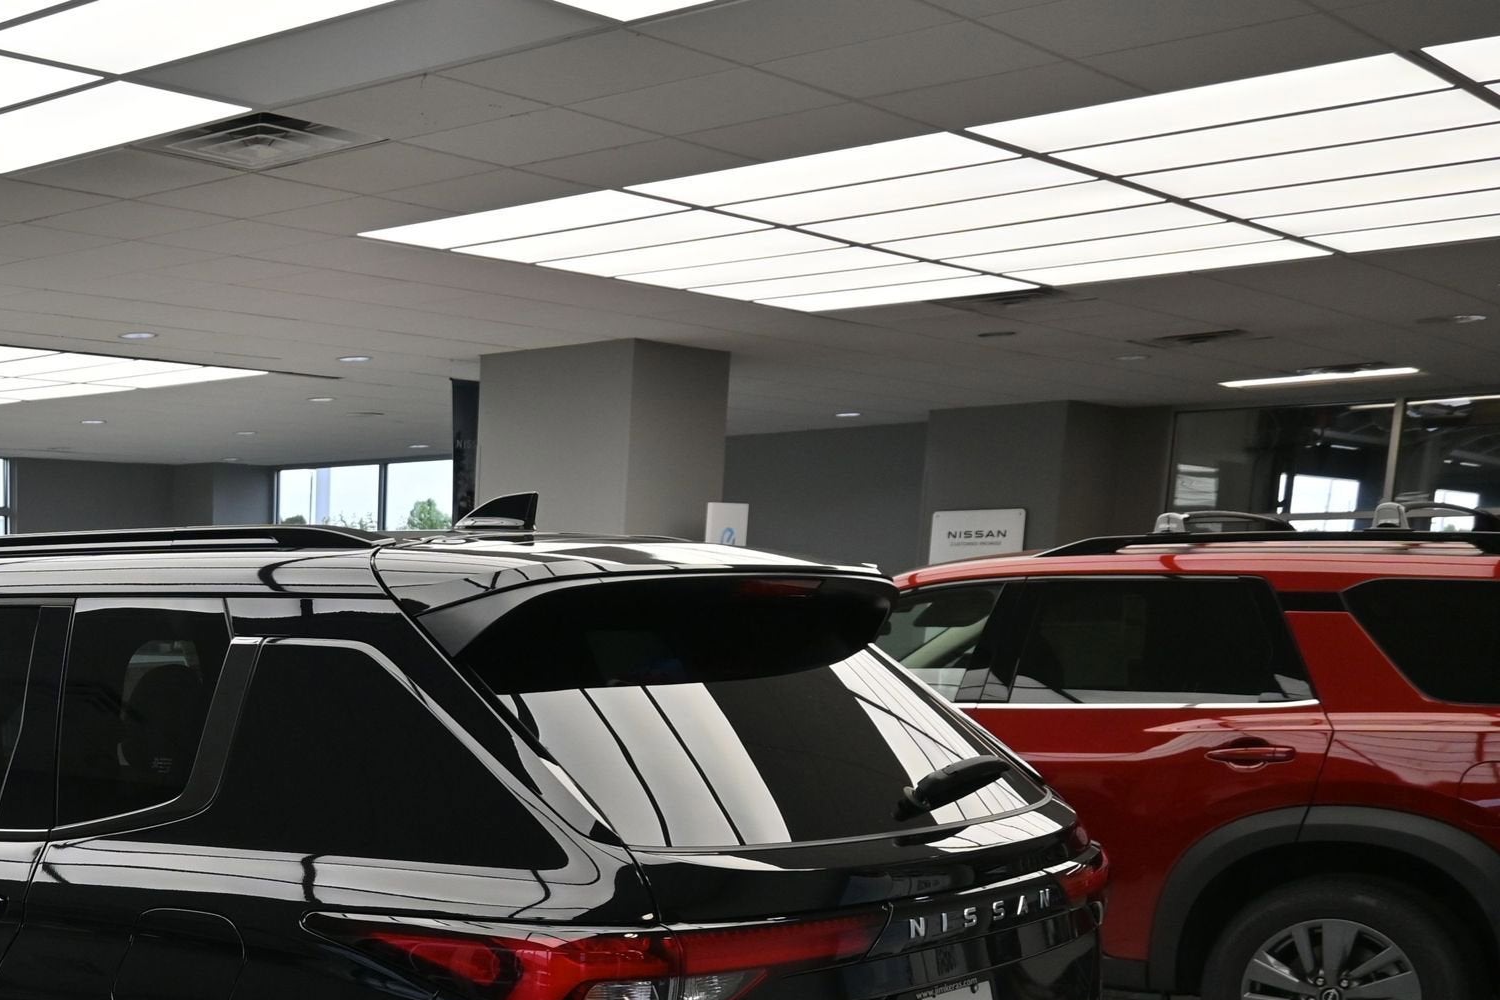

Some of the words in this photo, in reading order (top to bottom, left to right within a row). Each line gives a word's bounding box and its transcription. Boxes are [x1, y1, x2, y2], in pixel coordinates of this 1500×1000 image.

[947, 529, 1007, 539] NISSAN
[909, 888, 1050, 939] NISSAN
[915, 977, 978, 999] www.jimkeras.com
